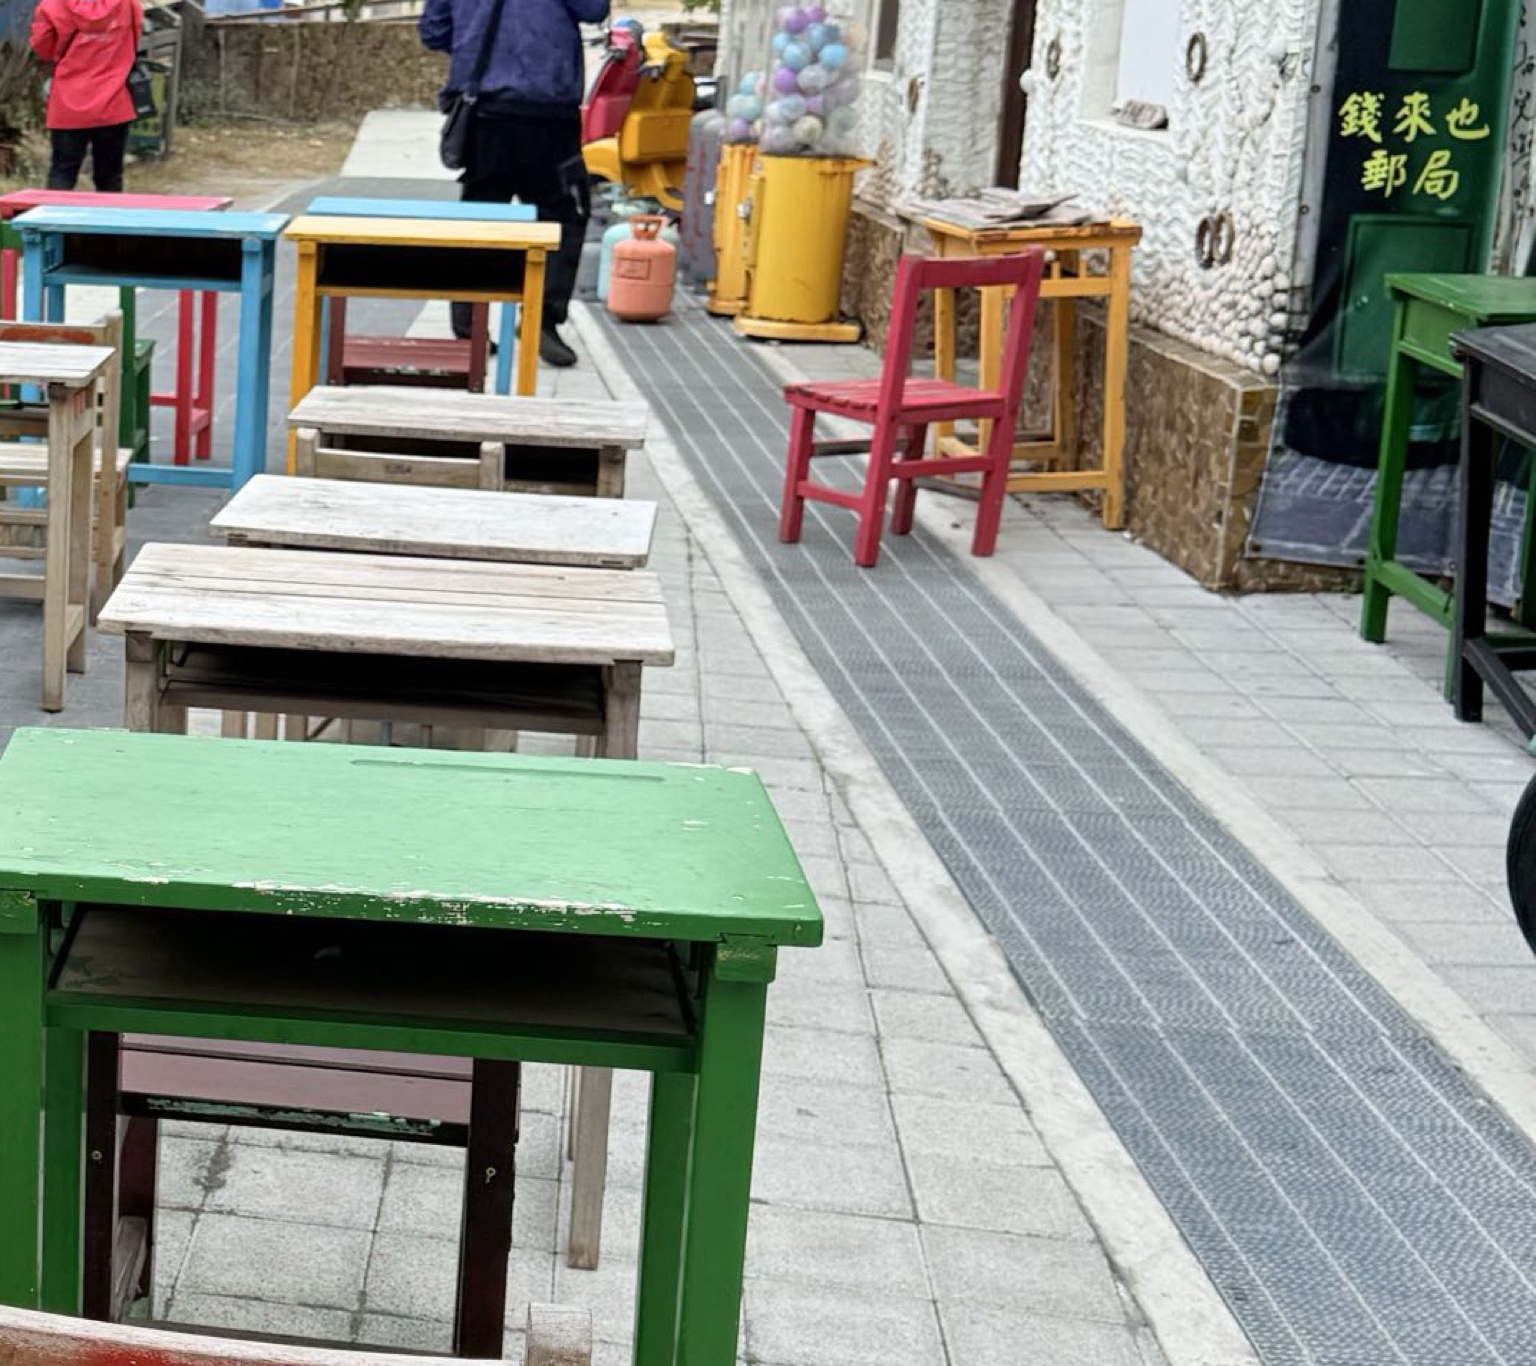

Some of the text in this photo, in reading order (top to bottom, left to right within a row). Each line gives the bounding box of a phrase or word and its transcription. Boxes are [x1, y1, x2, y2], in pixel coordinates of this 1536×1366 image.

[1337, 91, 1491, 142] 錢來也
[1360, 148, 1461, 201] 郵局
